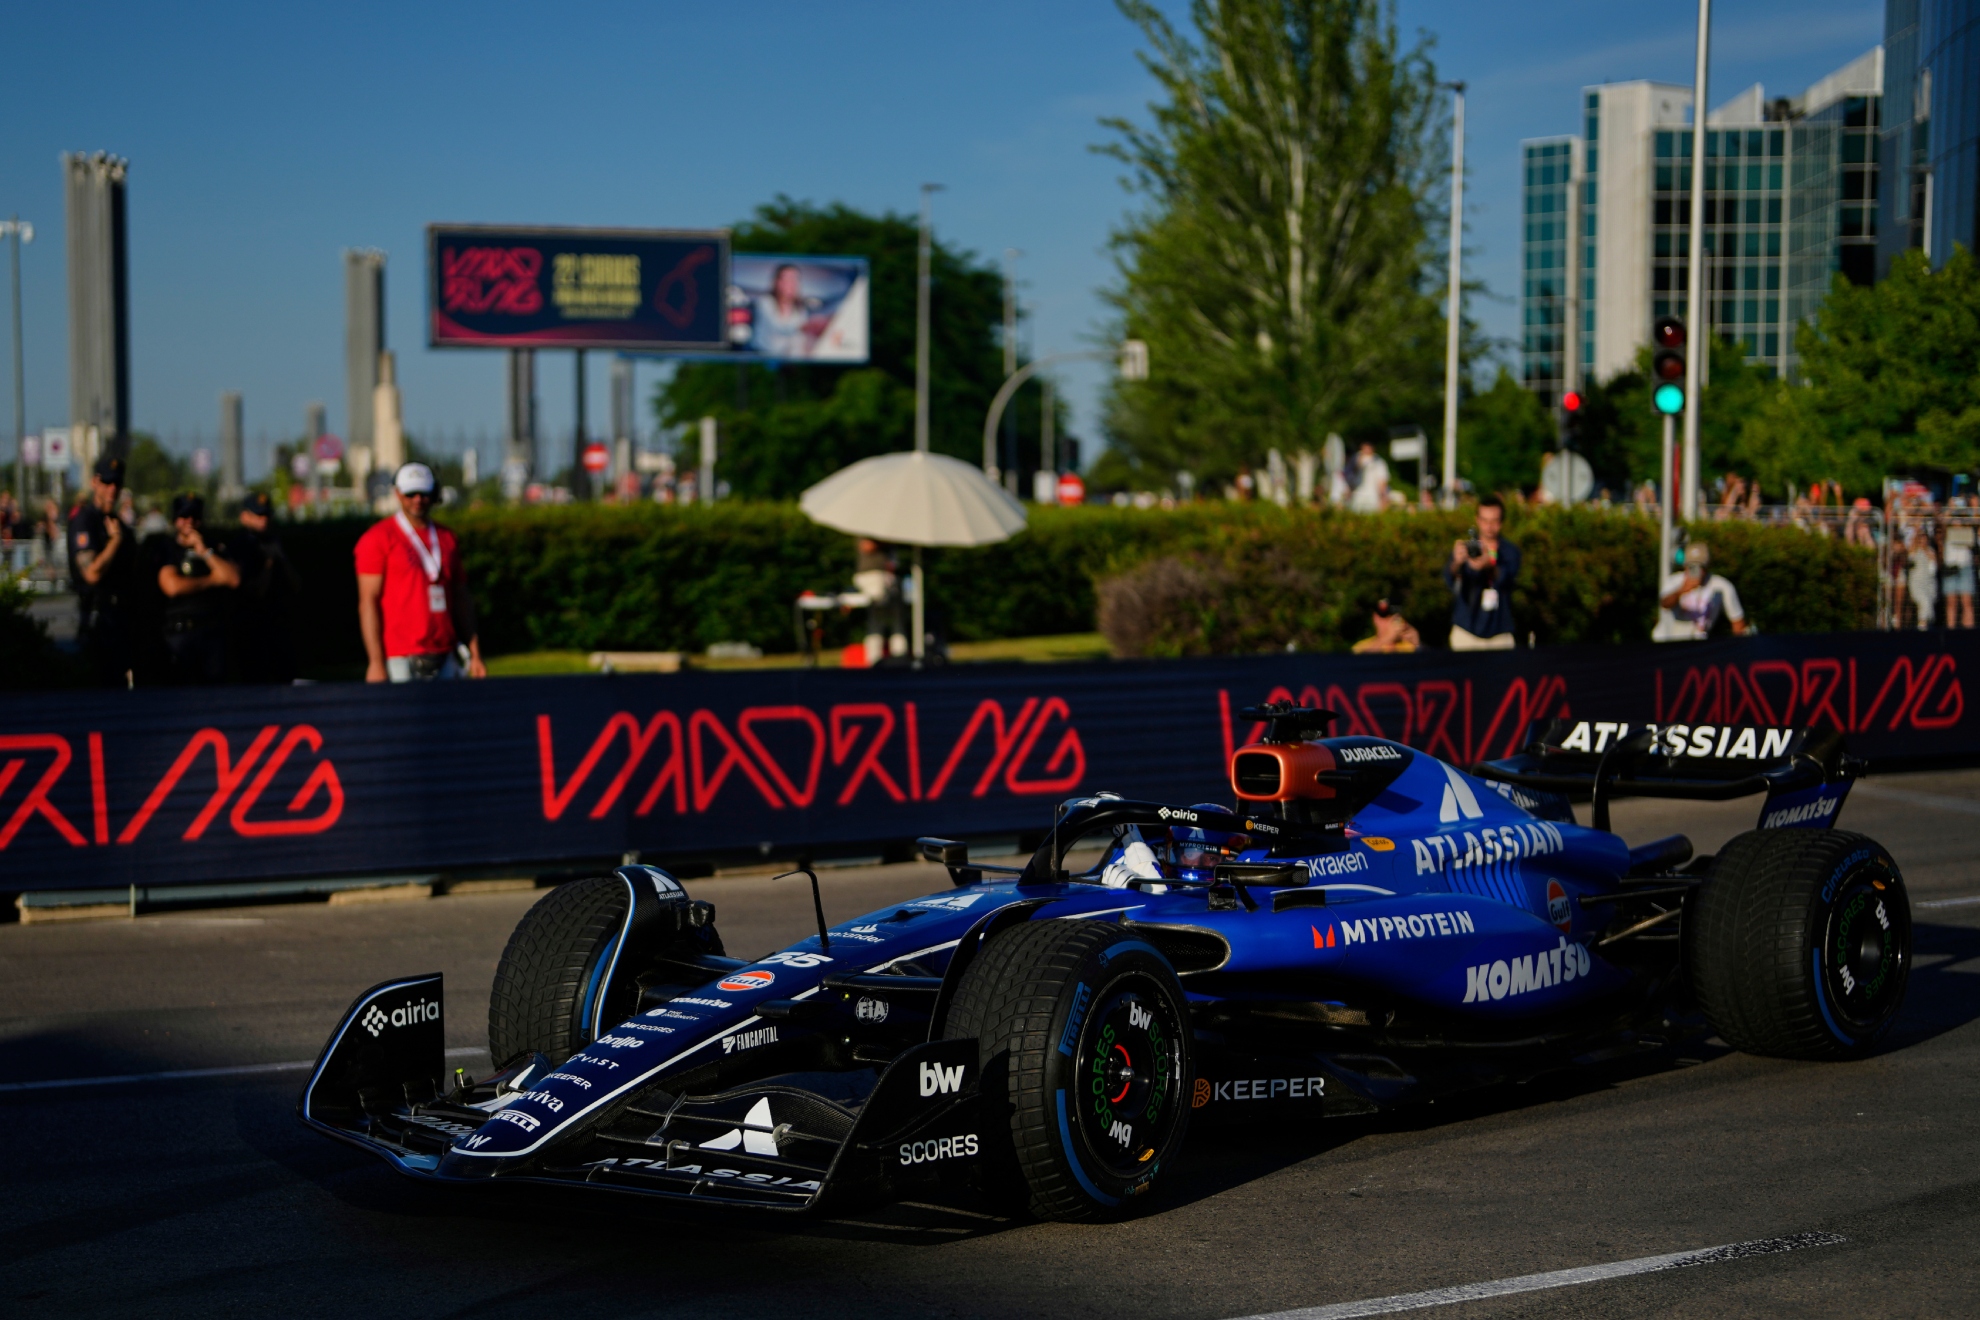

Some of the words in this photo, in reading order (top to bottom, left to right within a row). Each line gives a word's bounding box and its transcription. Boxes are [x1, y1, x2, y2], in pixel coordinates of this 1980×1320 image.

[537, 696, 1087, 821] MADRING
[1340, 746, 1402, 763] DURACELL
[1172, 808, 1198, 822] airia
[1764, 796, 1836, 829] KOMATSU
[1253, 822, 1280, 835] KEEPER
[1179, 841, 1218, 852] MYPROTEIN
[1411, 820, 1564, 877] ATLASSIAN
[1310, 851, 1369, 878] kraken
[1821, 848, 1870, 904] Cinturato
[658, 890, 685, 900] ATLASSIAN
[1550, 900, 1570, 920] Gulf
[1340, 911, 1475, 946] MYPROTEIN
[1837, 892, 1866, 965] SCORES
[1874, 899, 1890, 931] bw
[757, 951, 835, 968] 55
[1461, 935, 1591, 1004] KOMATSU
[1864, 931, 1892, 1000] SCORES
[724, 976, 769, 989] Gulf
[1838, 964, 1856, 997] bw
[391, 998, 440, 1028] airia
[669, 997, 733, 1009] KOMATSU
[637, 1024, 676, 1034] SCORES
[1058, 980, 1092, 1058] PIRELLI
[597, 1034, 644, 1050] brillo
[736, 1026, 779, 1051] FANCAPITAL
[580, 1055, 620, 1071] VAST
[1092, 1023, 1117, 1130] SCORES
[1130, 1001, 1151, 1030] bw
[1148, 1021, 1167, 1125] SCORES
[548, 1073, 593, 1091] KEEPER
[919, 1062, 965, 1097] bw
[1214, 1077, 1325, 1101] KEEPER
[1108, 1119, 1133, 1149] bw
[899, 1133, 979, 1166] SCORES
[582, 1157, 821, 1190] ATLASSIA
